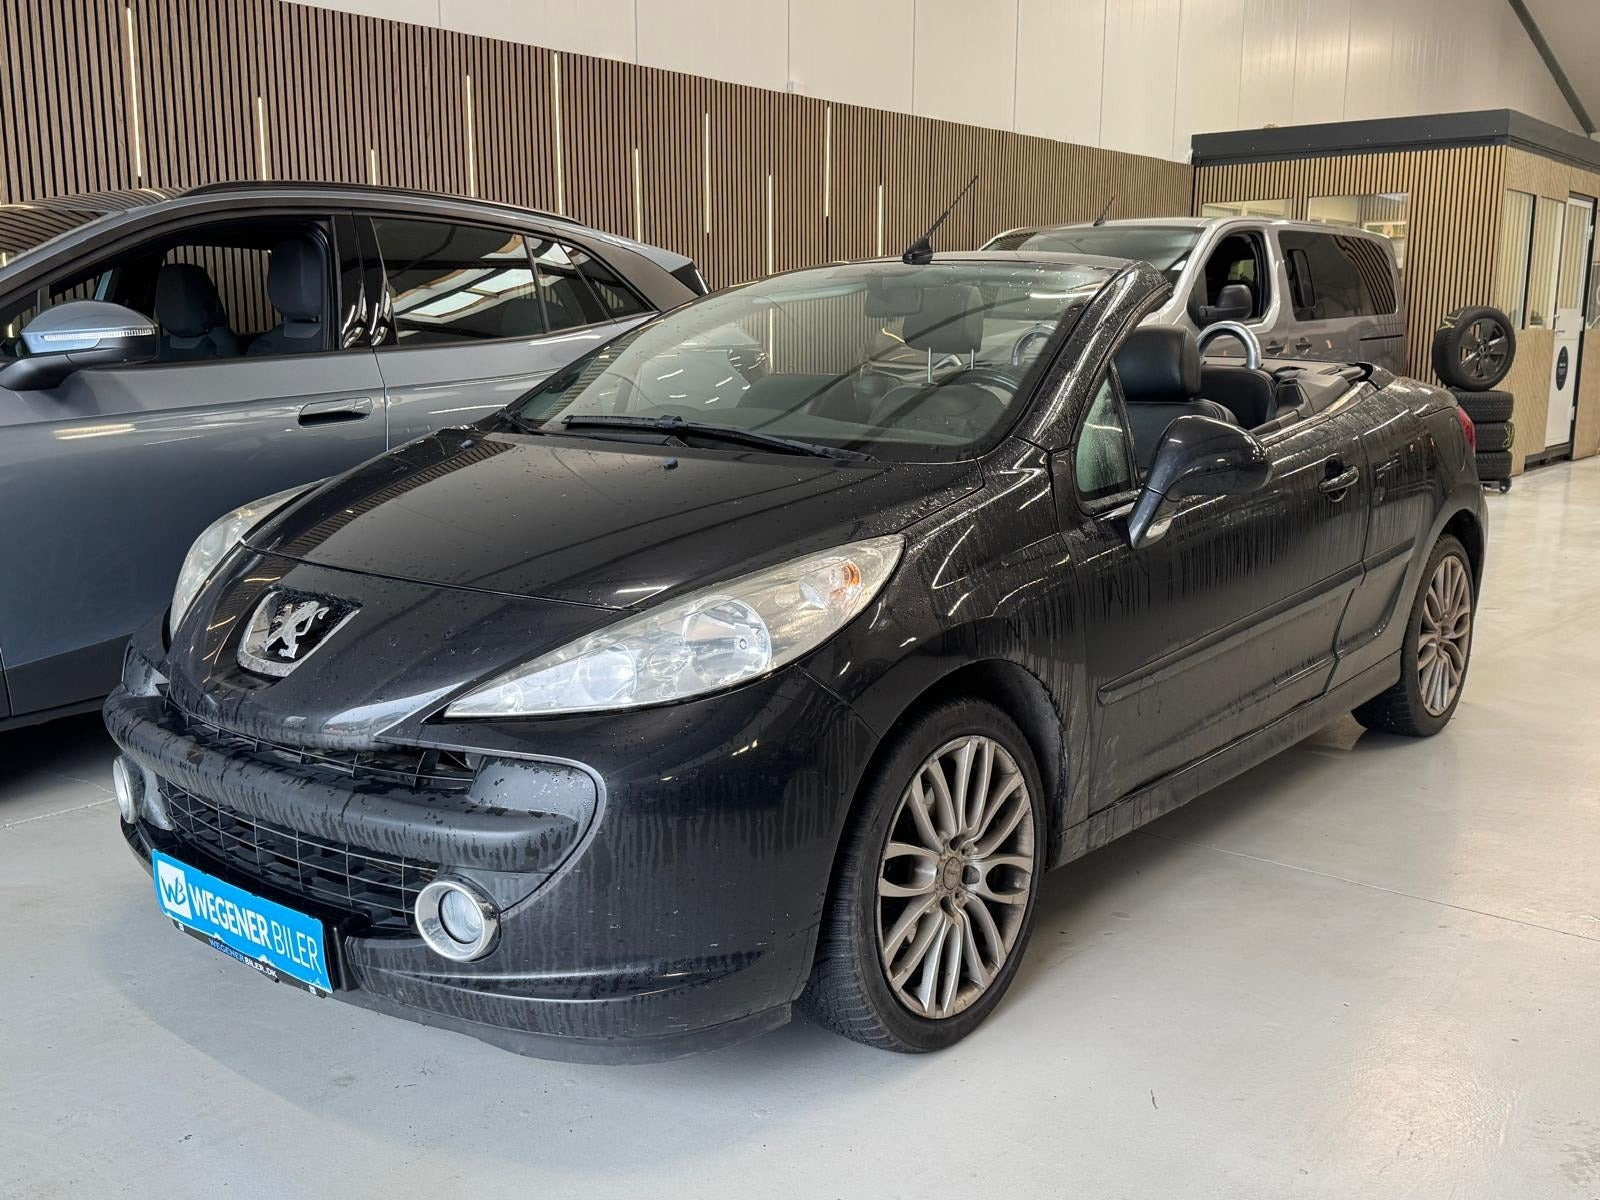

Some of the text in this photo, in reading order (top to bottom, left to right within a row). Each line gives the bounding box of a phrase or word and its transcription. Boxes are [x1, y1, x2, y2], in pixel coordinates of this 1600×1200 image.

[162, 877, 186, 904] WB
[189, 884, 322, 974] WEGENER BILER
